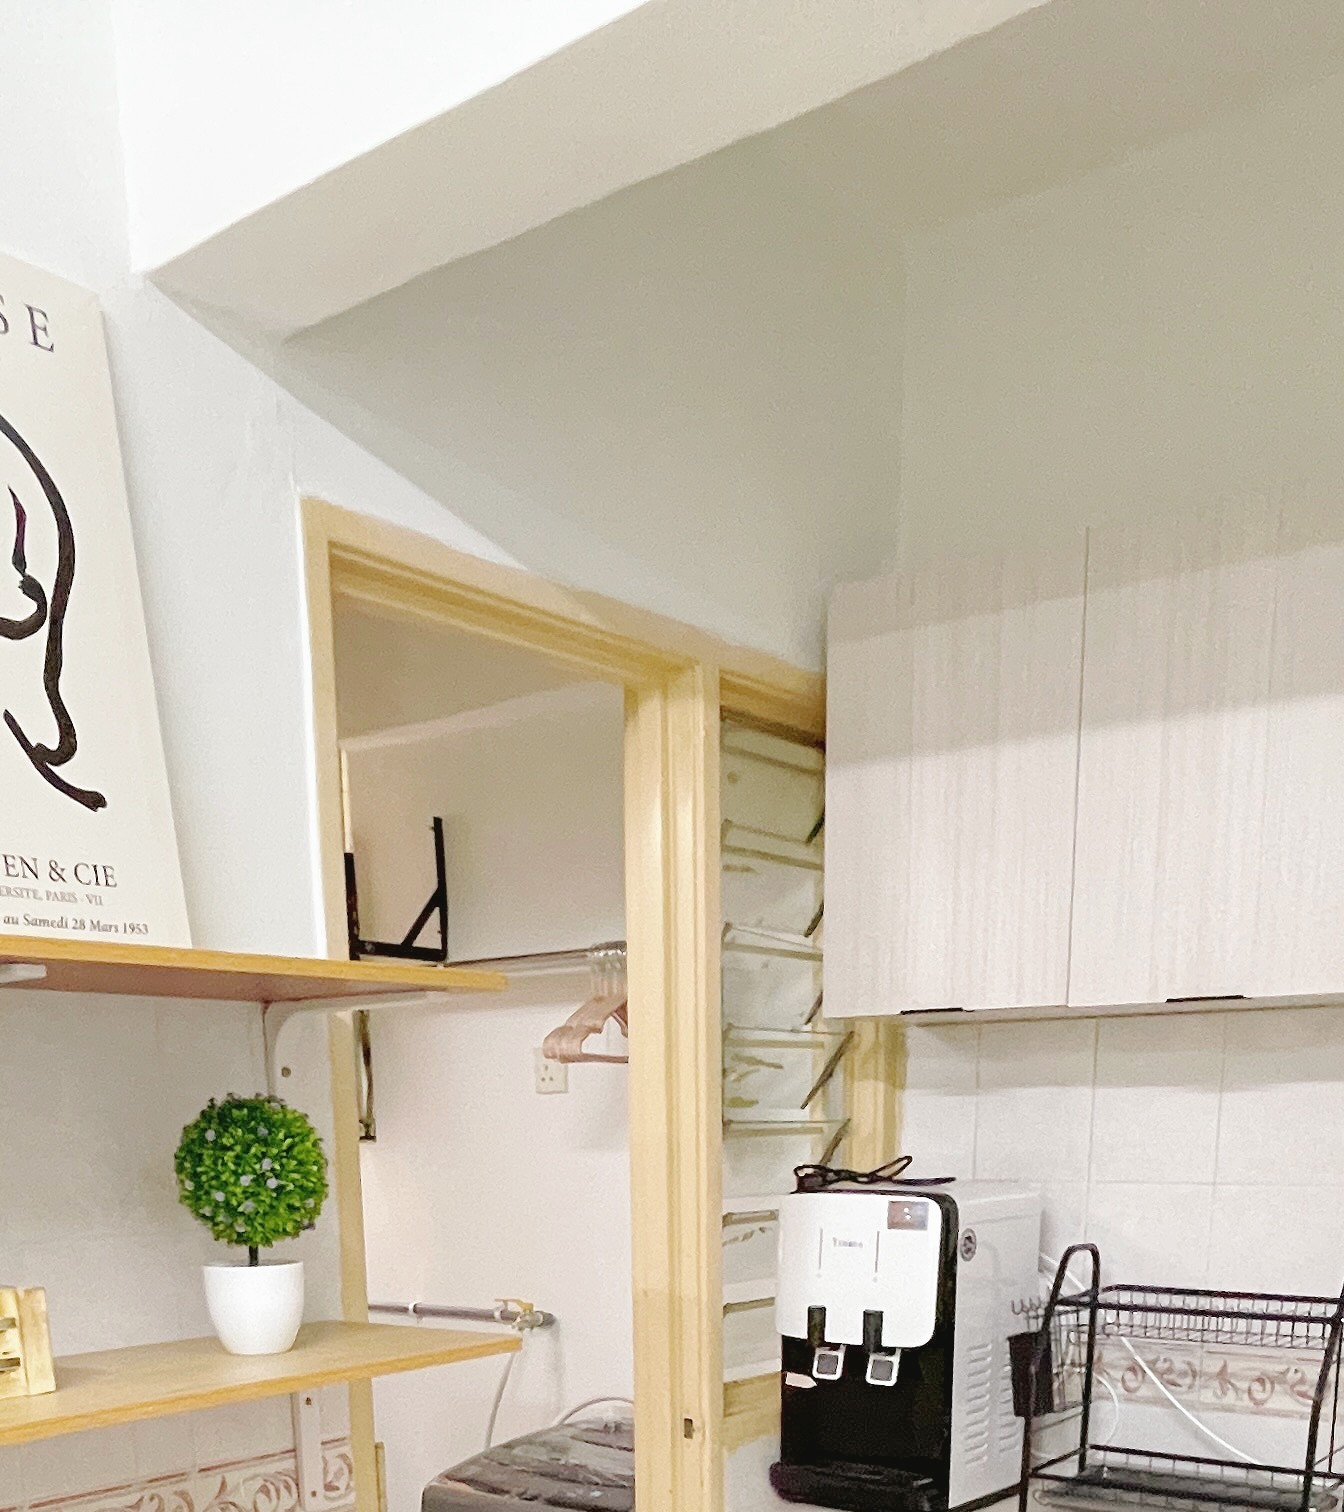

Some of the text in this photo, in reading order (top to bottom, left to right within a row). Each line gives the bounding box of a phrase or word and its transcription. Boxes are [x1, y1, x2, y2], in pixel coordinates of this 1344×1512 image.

[48, 858, 68, 884] &
[73, 861, 118, 888] CIE
[45, 889, 79, 904] PARIS
[85, 892, 104, 907] VII
[3, 915, 19, 926] au
[23, 912, 69, 930] Samedi
[71, 917, 86, 931] 28
[89, 919, 119, 935] Mars
[122, 922, 149, 936] 1953
